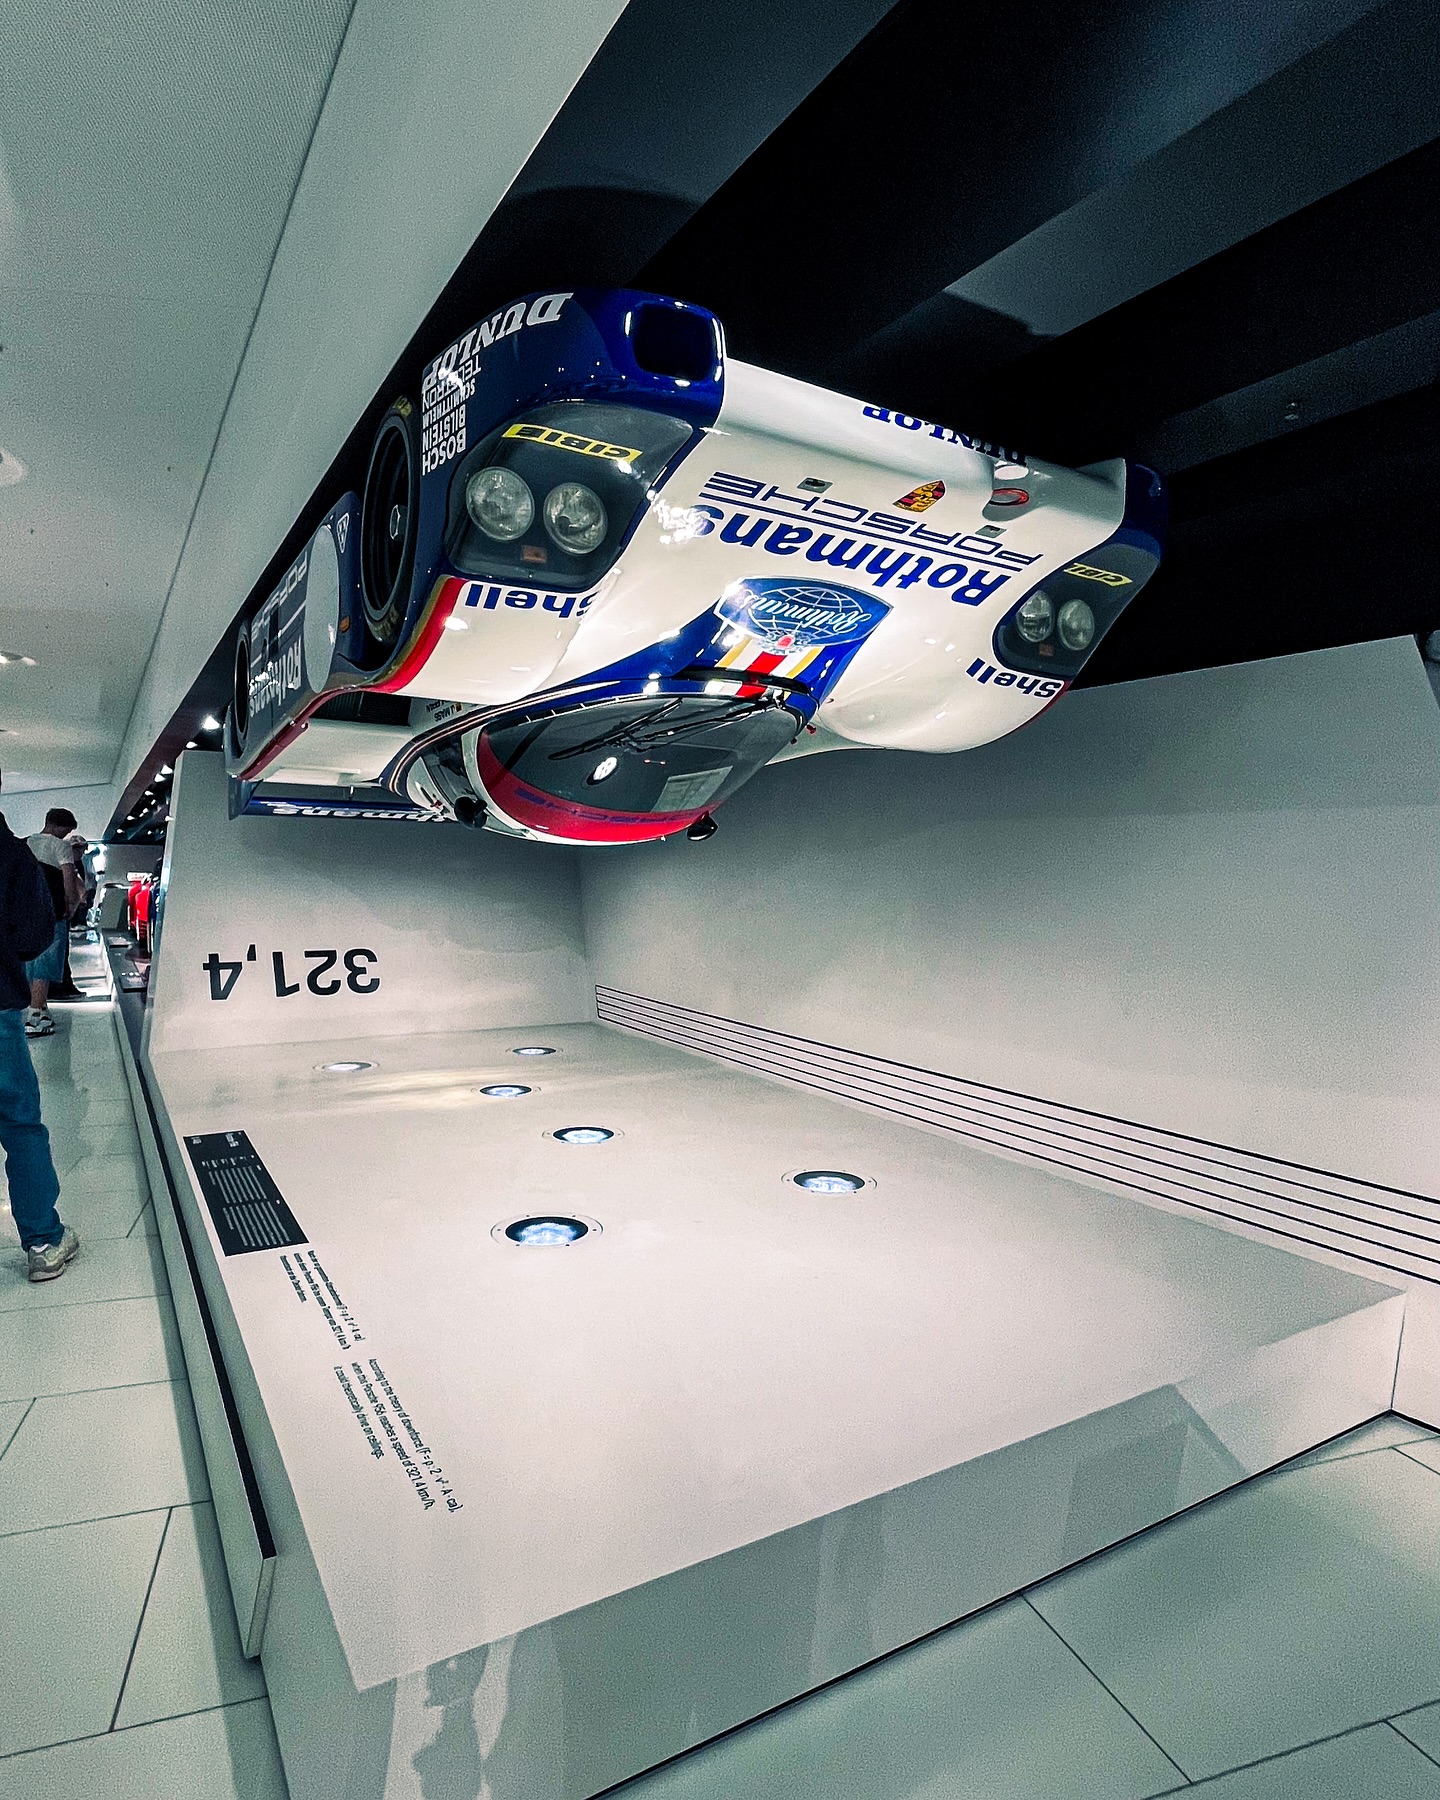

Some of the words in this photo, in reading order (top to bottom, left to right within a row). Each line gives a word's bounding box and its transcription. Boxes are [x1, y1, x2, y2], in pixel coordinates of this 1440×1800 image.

[422, 292, 574, 395] DUNLOP
[422, 404, 466, 453] BILSTEIN
[514, 426, 631, 458] CIBIE
[422, 427, 467, 476] BOSCH
[698, 471, 1043, 566] PORSCHE
[1070, 565, 1123, 583] CIBI
[739, 589, 872, 634] Rothmans
[965, 657, 1062, 698] Shell
[203, 943, 381, 1001] 321,4
[362, 1383, 378, 1403] Porsche
[383, 1386, 394, 1395] the
[388, 1395, 403, 1412] theory
[356, 1413, 369, 1427] drive
[373, 1403, 387, 1415] 956
[378, 1415, 396, 1437] reaches
[391, 1441, 411, 1460] speed
